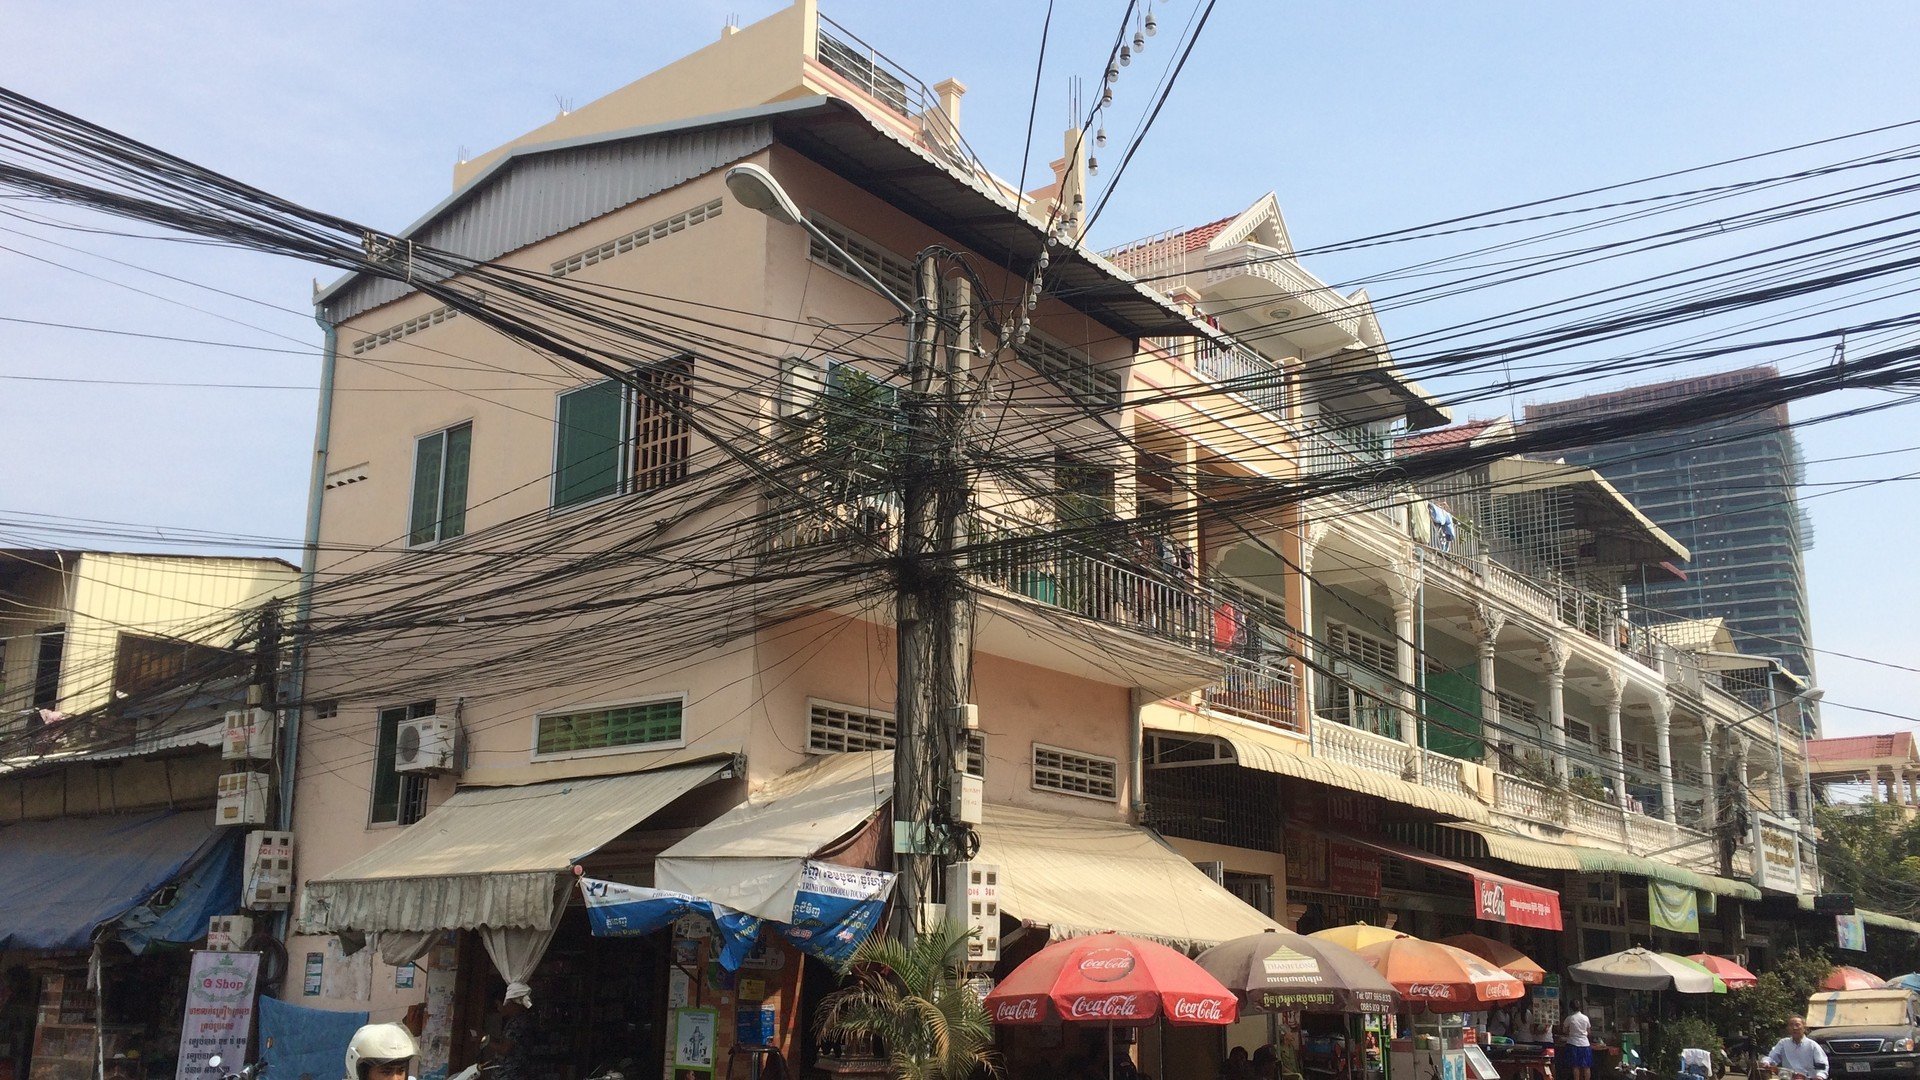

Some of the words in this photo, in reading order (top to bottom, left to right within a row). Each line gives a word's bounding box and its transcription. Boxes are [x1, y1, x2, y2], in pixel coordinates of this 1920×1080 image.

[1081, 958, 1130, 970] Coca-Cola
[215, 979, 244, 991] Shop
[1409, 982, 1451, 998] Coca-Cola
[1485, 982, 1511, 998] Coca-Cola
[997, 998, 1038, 1021] Coca-Cola
[1072, 994, 1138, 1017] Coca-Cola
[1174, 998, 1223, 1020] Coca-Cola
